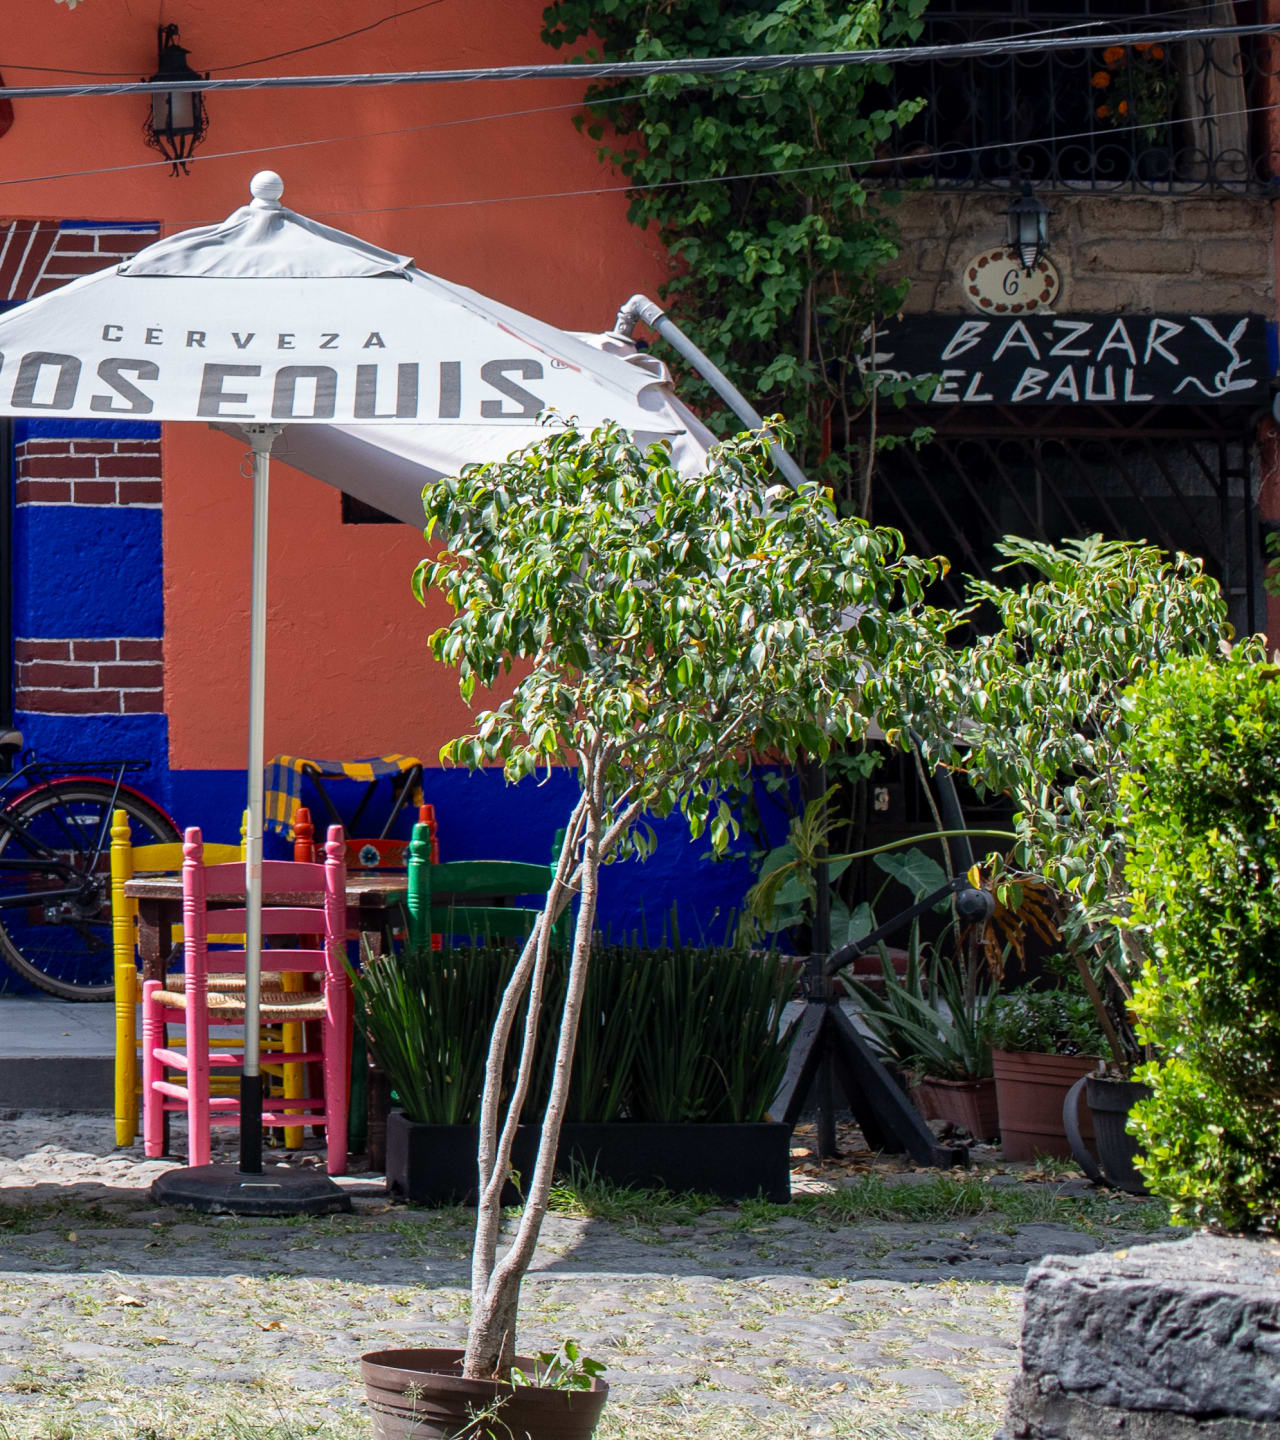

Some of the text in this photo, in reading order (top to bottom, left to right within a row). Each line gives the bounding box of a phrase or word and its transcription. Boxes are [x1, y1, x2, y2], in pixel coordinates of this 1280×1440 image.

[1002, 268, 1020, 296] 6
[101, 324, 386, 350] CERVEZA
[196, 357, 545, 420] EQUIS
[931, 364, 1155, 403] EL BAUL
